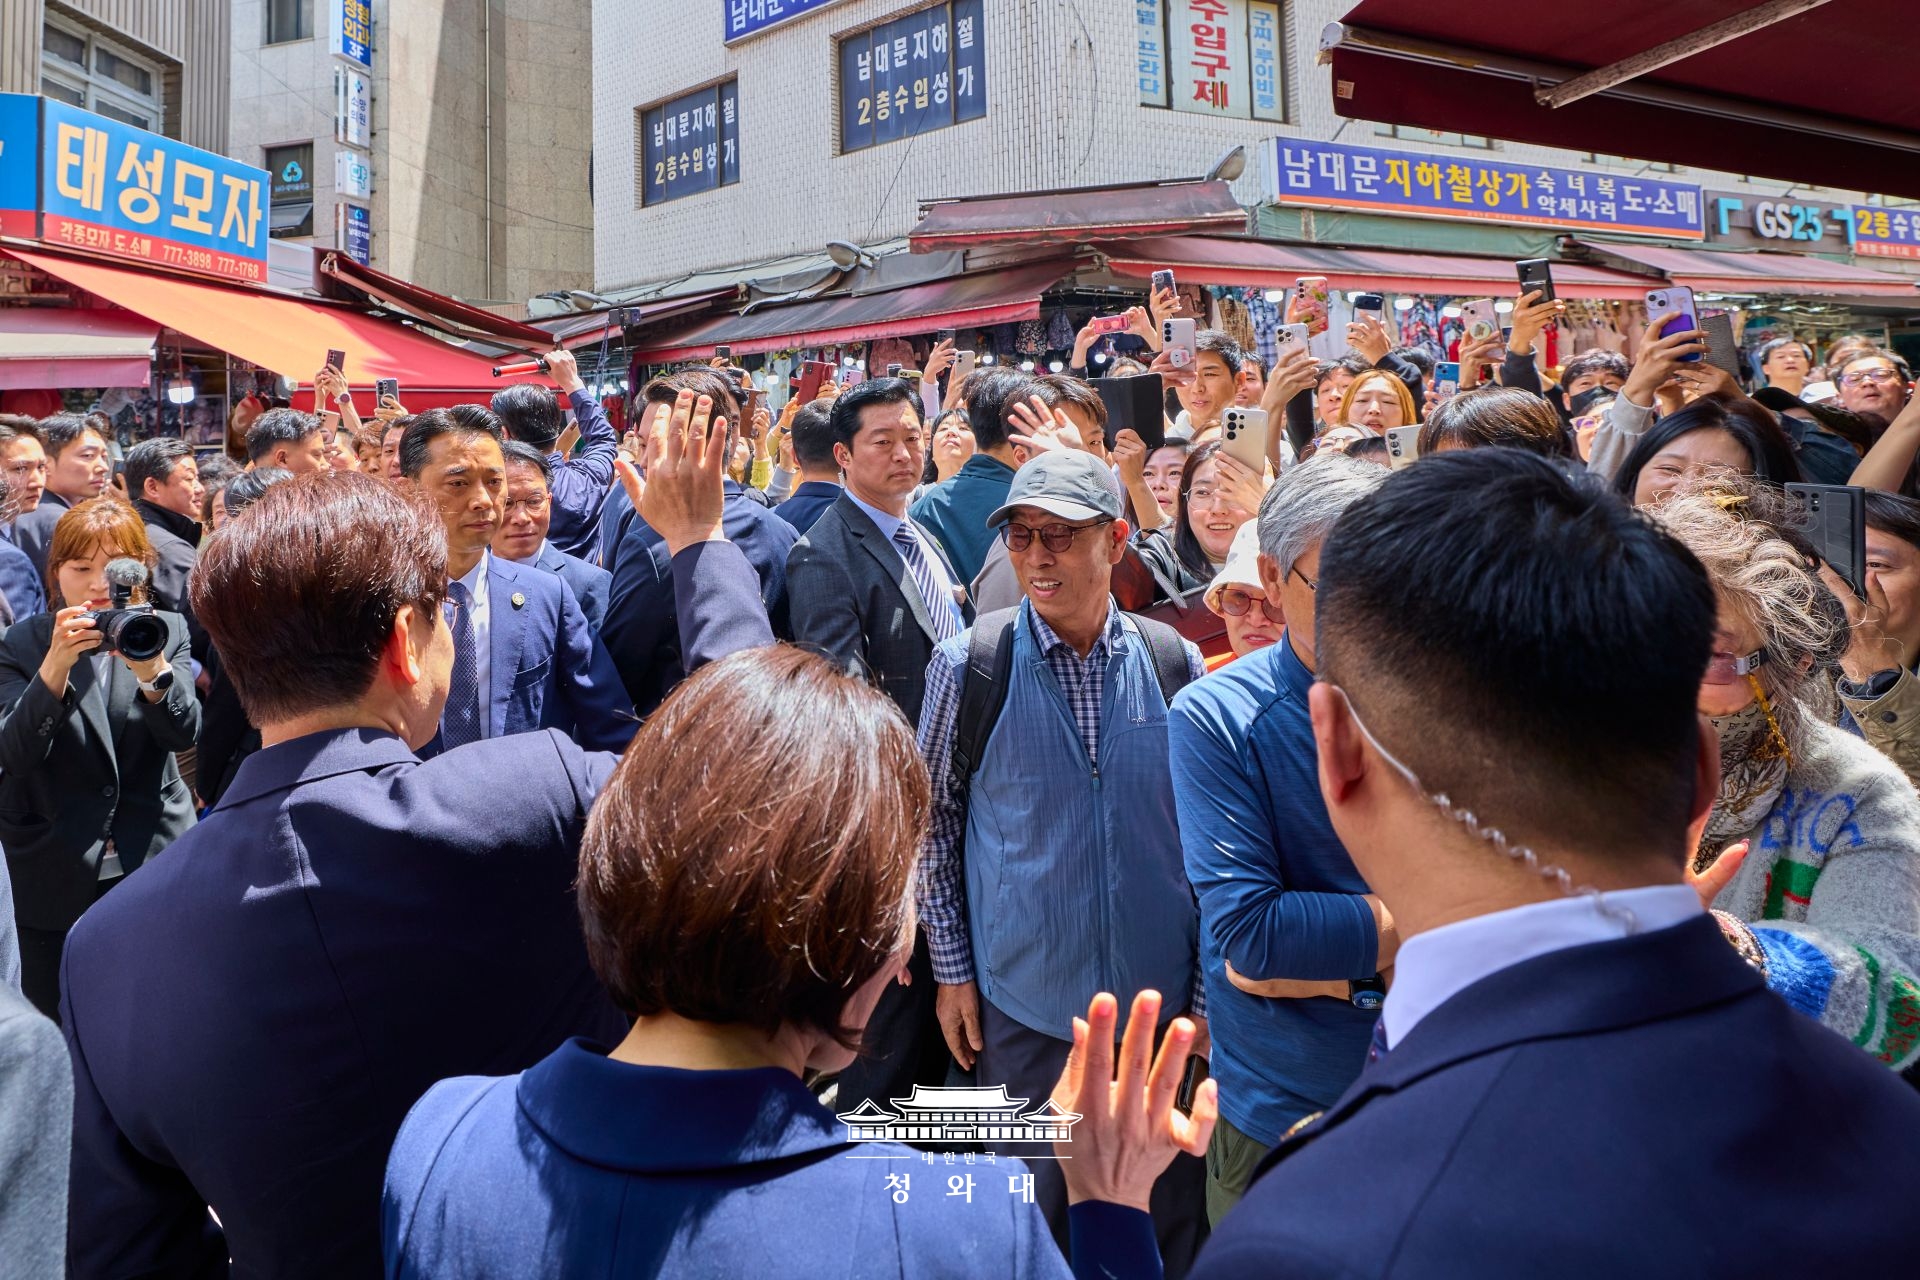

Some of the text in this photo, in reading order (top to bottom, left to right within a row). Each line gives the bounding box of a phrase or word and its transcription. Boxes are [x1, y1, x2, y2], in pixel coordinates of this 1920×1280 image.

[344, 17, 369, 48] 외과
[349, 40, 365, 59] 3F
[858, 16, 974, 81] 남대문지하철
[1188, 0, 1231, 109] 수입구제
[858, 65, 974, 125] 2층수입상가
[654, 97, 735, 147] 남대문지하철
[56, 122, 262, 248] 태성모자
[655, 138, 735, 185] 2층수입상가
[1537, 195, 1617, 221] 악세사리
[1756, 201, 1823, 241] GS25
[60, 221, 111, 249] 각종모자
[163, 244, 211, 269] 777-3898
[217, 256, 259, 279] 777-1768
